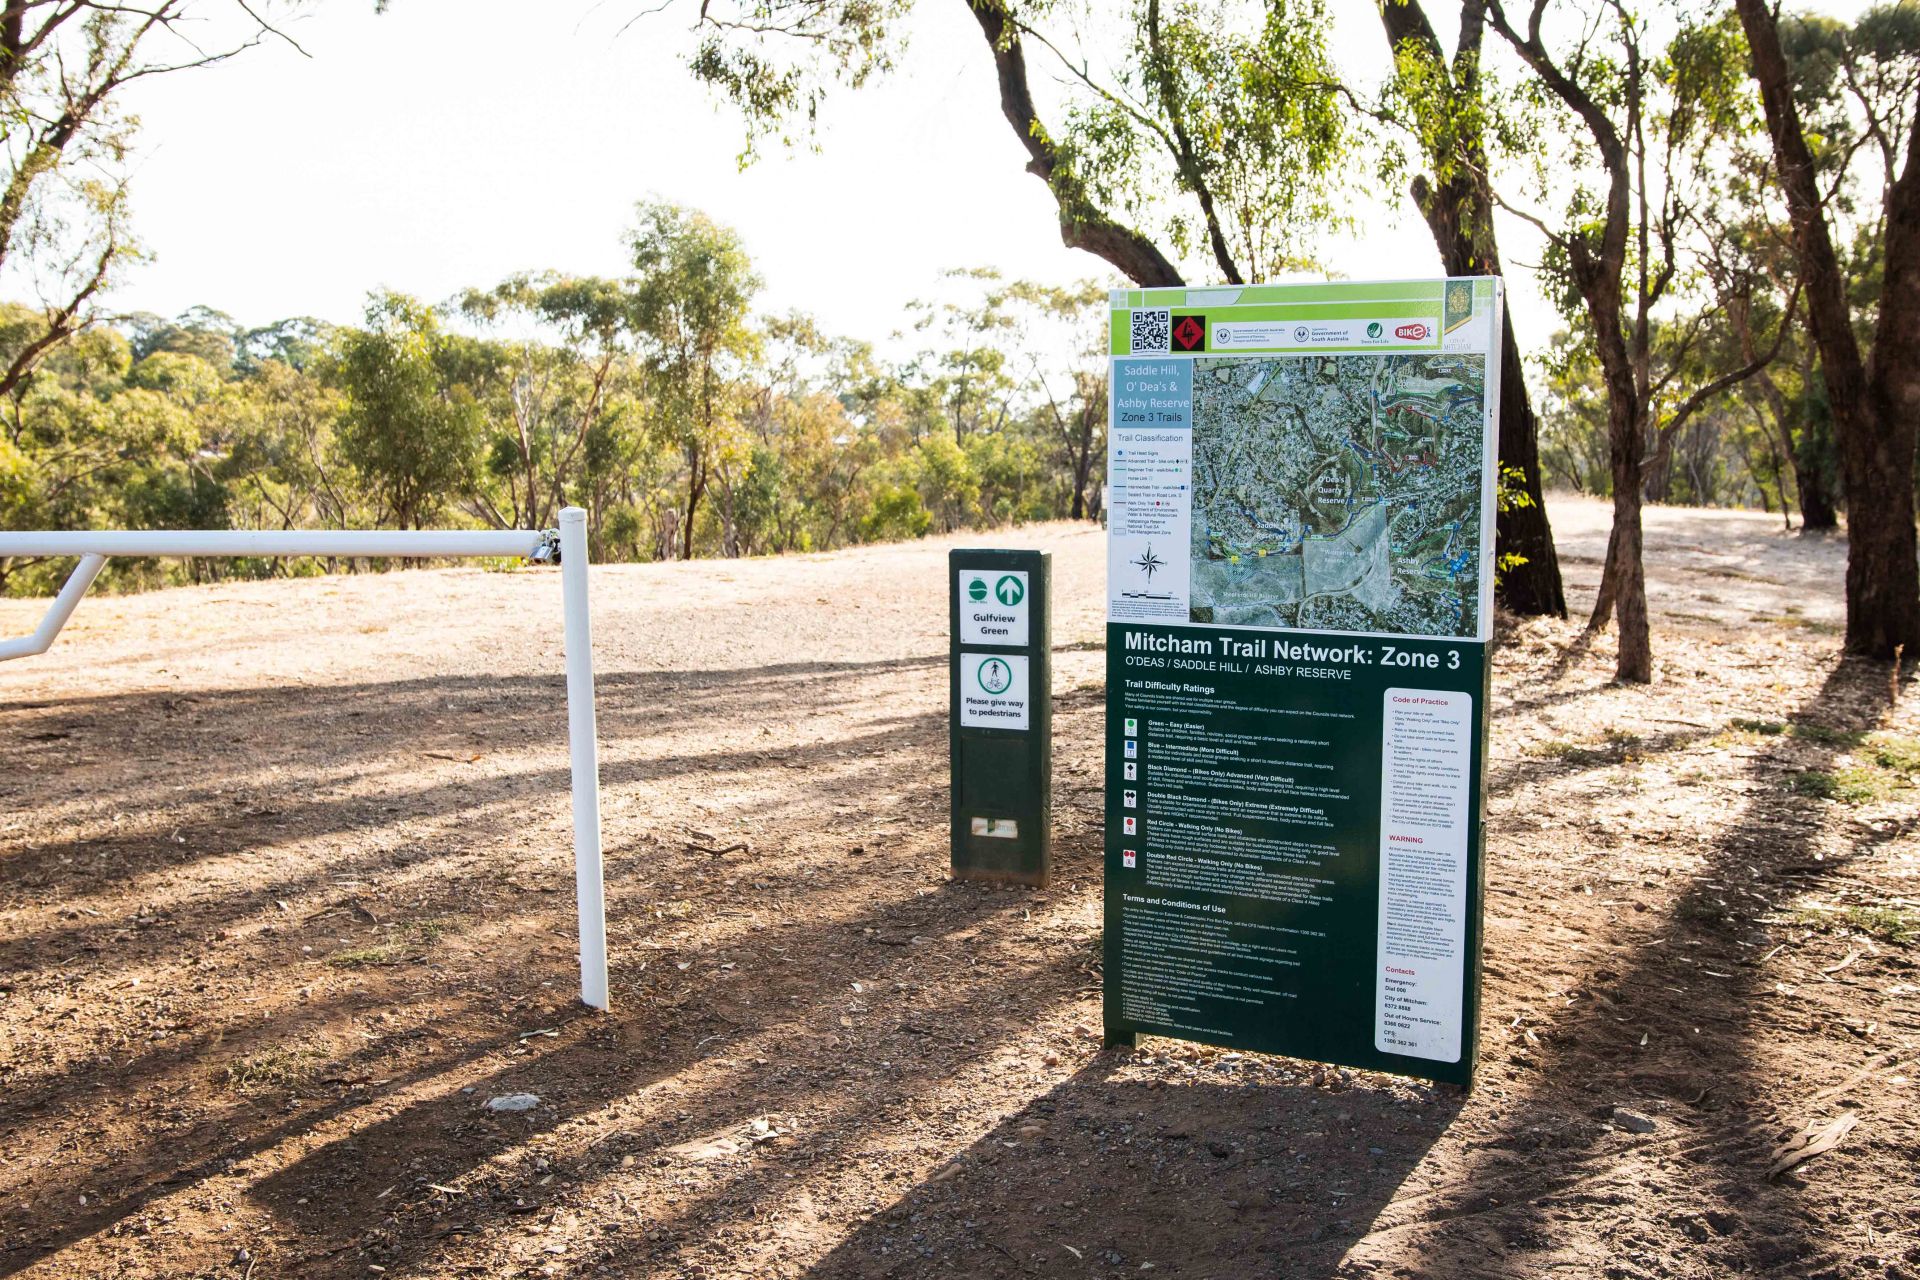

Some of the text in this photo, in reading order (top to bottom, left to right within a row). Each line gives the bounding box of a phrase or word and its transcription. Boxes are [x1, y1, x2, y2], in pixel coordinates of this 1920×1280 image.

[1124, 365, 1180, 377] Saddle Hill,
[1139, 381, 1167, 392] Dea's
[1169, 381, 1178, 392] &
[1117, 397, 1190, 410] Ashby Reserve
[1121, 412, 1183, 422] Zone 3 Trails
[1117, 433, 1184, 442] Trail Classification
[1317, 486, 1343, 494] Quarry
[1317, 496, 1346, 504] Reserve
[1397, 557, 1420, 566] Ashby
[1397, 567, 1426, 575] Reserve
[973, 613, 1016, 623] Gulfview
[980, 626, 1009, 635] Green
[1125, 631, 1461, 670] Mitcham Trail Network: Zone 3
[1125, 656, 1352, 680] O'DEAS / SADDLE HILL / ASHBY RESERVE
[1125, 679, 1215, 695] Trail Difficulty Ratings
[965, 697, 1024, 709] Please give way
[1392, 696, 1411, 704] Code
[1420, 697, 1449, 706] Practice
[978, 709, 1022, 718] pedestrians
[1147, 719, 1165, 727] Green
[1169, 721, 1183, 729] Easy
[1183, 723, 1205, 731] (Easier)
[1147, 741, 1161, 749] Blue
[1165, 743, 1199, 752] Intermediate
[1199, 746, 1215, 754] (More
[1215, 747, 1239, 757] Difficult)
[1147, 763, 1163, 771] Black
[1163, 765, 1188, 773] Diamond
[1192, 768, 1210, 776] (Bikes
[1210, 769, 1225, 778] Only)
[1226, 771, 1254, 780] Advanced
[1254, 774, 1270, 782] (Very
[1270, 775, 1295, 785] Difficult)
[1147, 791, 1166, 799] Double
[1166, 793, 1182, 801] Black
[1182, 795, 1207, 803] Diamond
[1210, 798, 1229, 806] (Bikes
[1229, 799, 1245, 808] Only)
[1245, 801, 1268, 809] Extreme
[1268, 803, 1299, 813] (Extremely
[1299, 806, 1324, 816] Difficult)
[1146, 818, 1158, 826] Red
[1178, 822, 1200, 831] Walking
[1200, 824, 1214, 833] Only
[1224, 827, 1243, 836] Bikes)
[1388, 834, 1424, 844] WARNING
[1146, 851, 1166, 859] Double
[1177, 855, 1194, 863] Circle
[1197, 858, 1220, 867] Walking
[1219, 860, 1233, 868] Only
[1233, 861, 1244, 869] (No
[1244, 863, 1263, 872] Bikes)
[1122, 893, 1227, 914] Terms and Conditions of Use
[1385, 966, 1415, 976] Contacts
[1419, 1017, 1442, 1026] Service:
